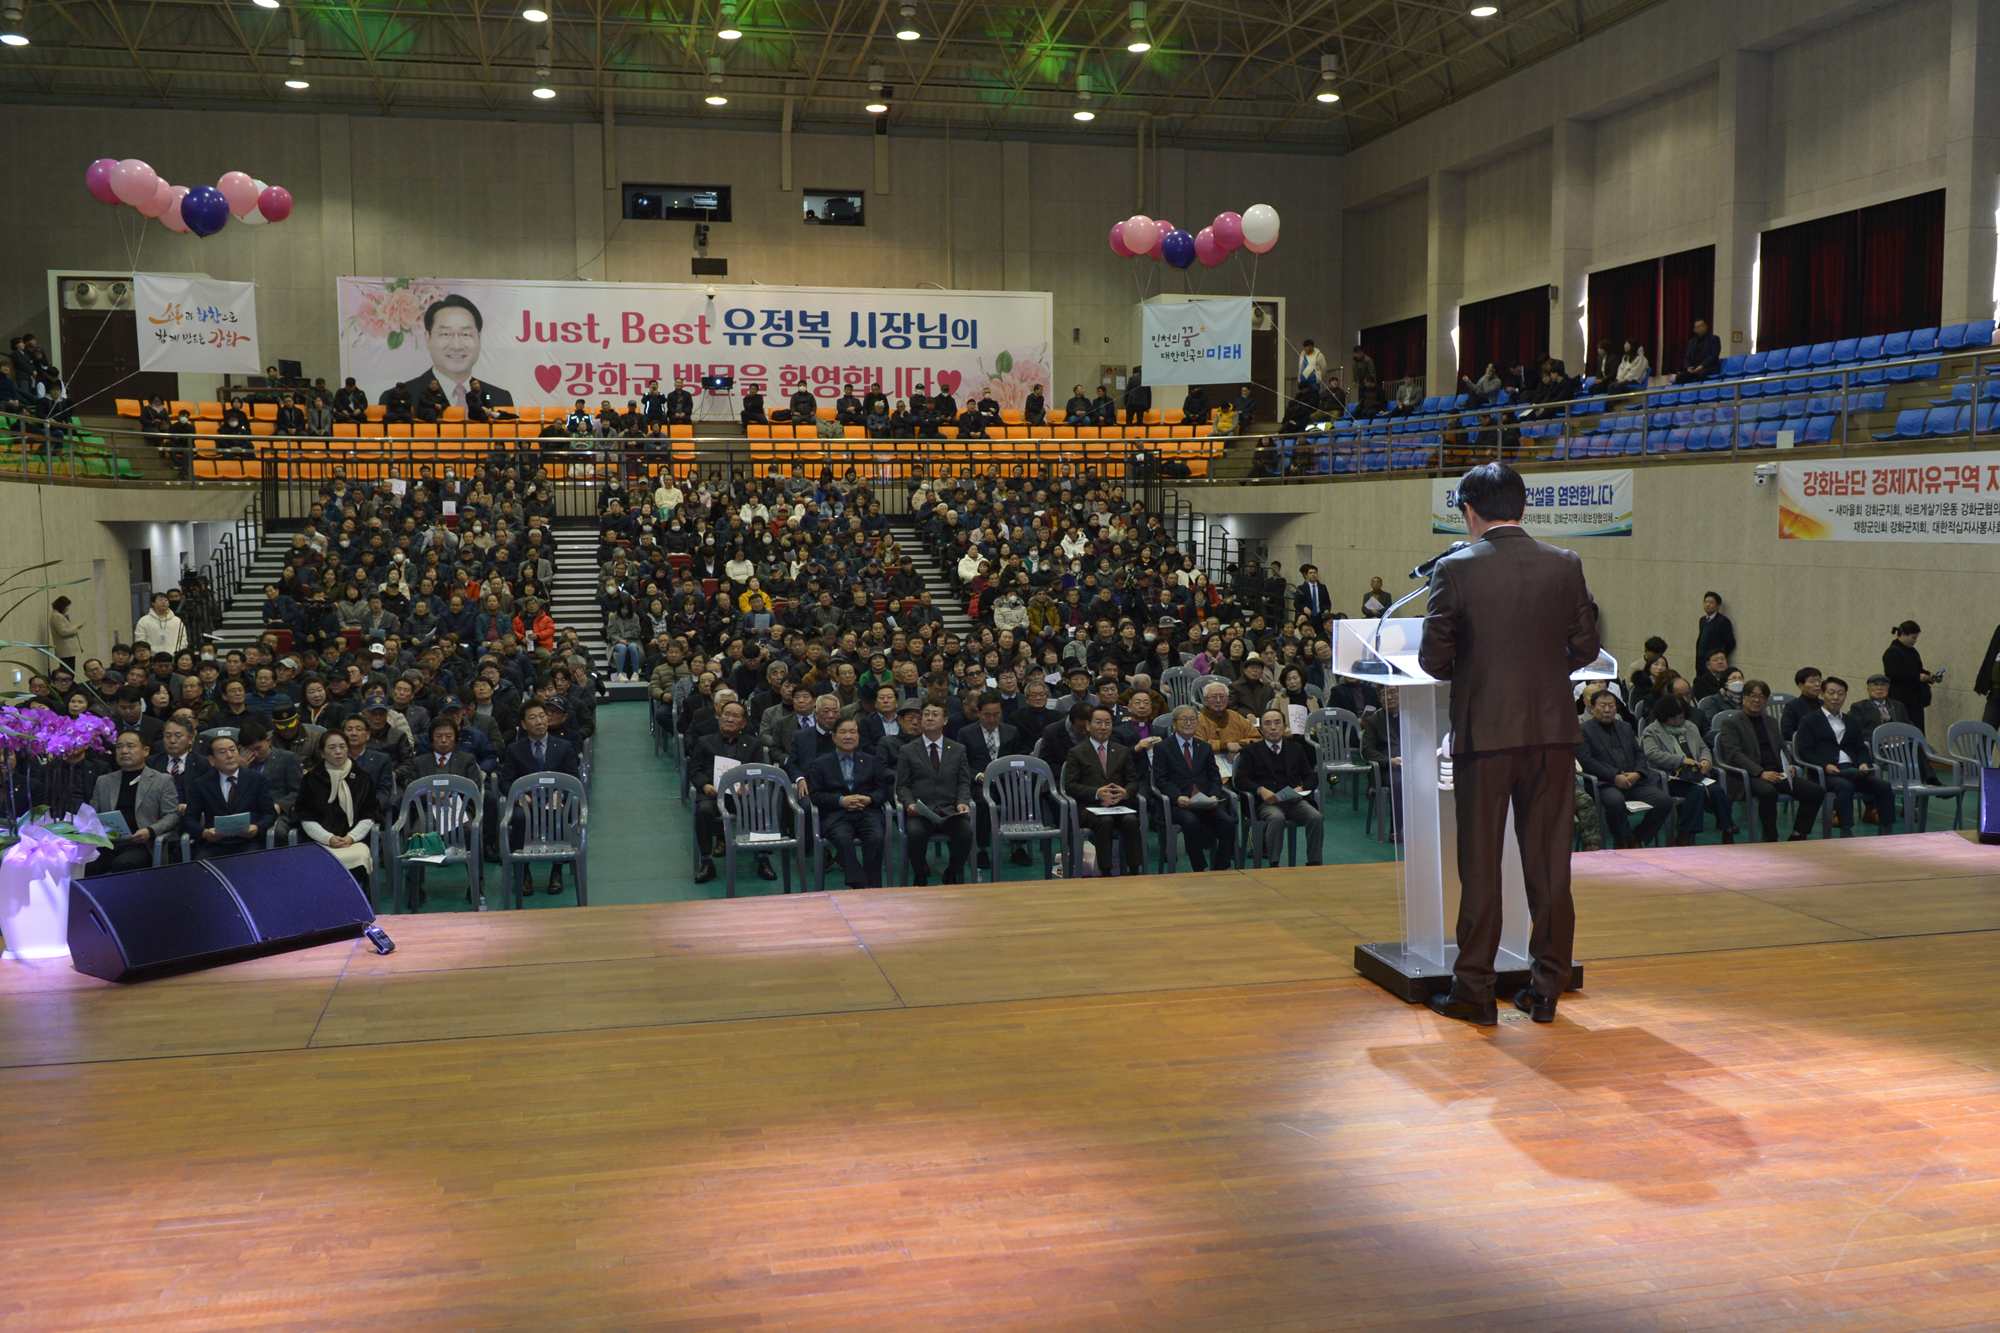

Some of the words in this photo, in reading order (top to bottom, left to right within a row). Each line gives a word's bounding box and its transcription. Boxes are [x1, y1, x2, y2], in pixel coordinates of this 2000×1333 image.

[182, 332, 205, 345] 만드는
[207, 328, 251, 348] 강화
[515, 309, 611, 350] Just,
[621, 311, 712, 345] Best
[722, 308, 831, 348] 유정복
[844, 311, 978, 350] 시장님의
[1151, 333, 1180, 348] 인천의
[1181, 326, 1200, 347] 꿈
[1160, 348, 1205, 362] 대한민국의
[1206, 343, 1242, 360] 미래
[564, 362, 663, 396] 강화군
[778, 364, 936, 399] 환영합니다
[1803, 470, 1867, 497] 강화남단
[1872, 465, 1980, 496] 경제자유구역
[1558, 484, 1614, 507] 염원합니다
[1835, 503, 1863, 517] 새마을회
[1865, 503, 1902, 517] 강화군지회,
[1905, 502, 1958, 517] 바르게살기운동
[1853, 521, 1888, 534] 재향군인회
[1890, 521, 1929, 535] 강화군지회,
